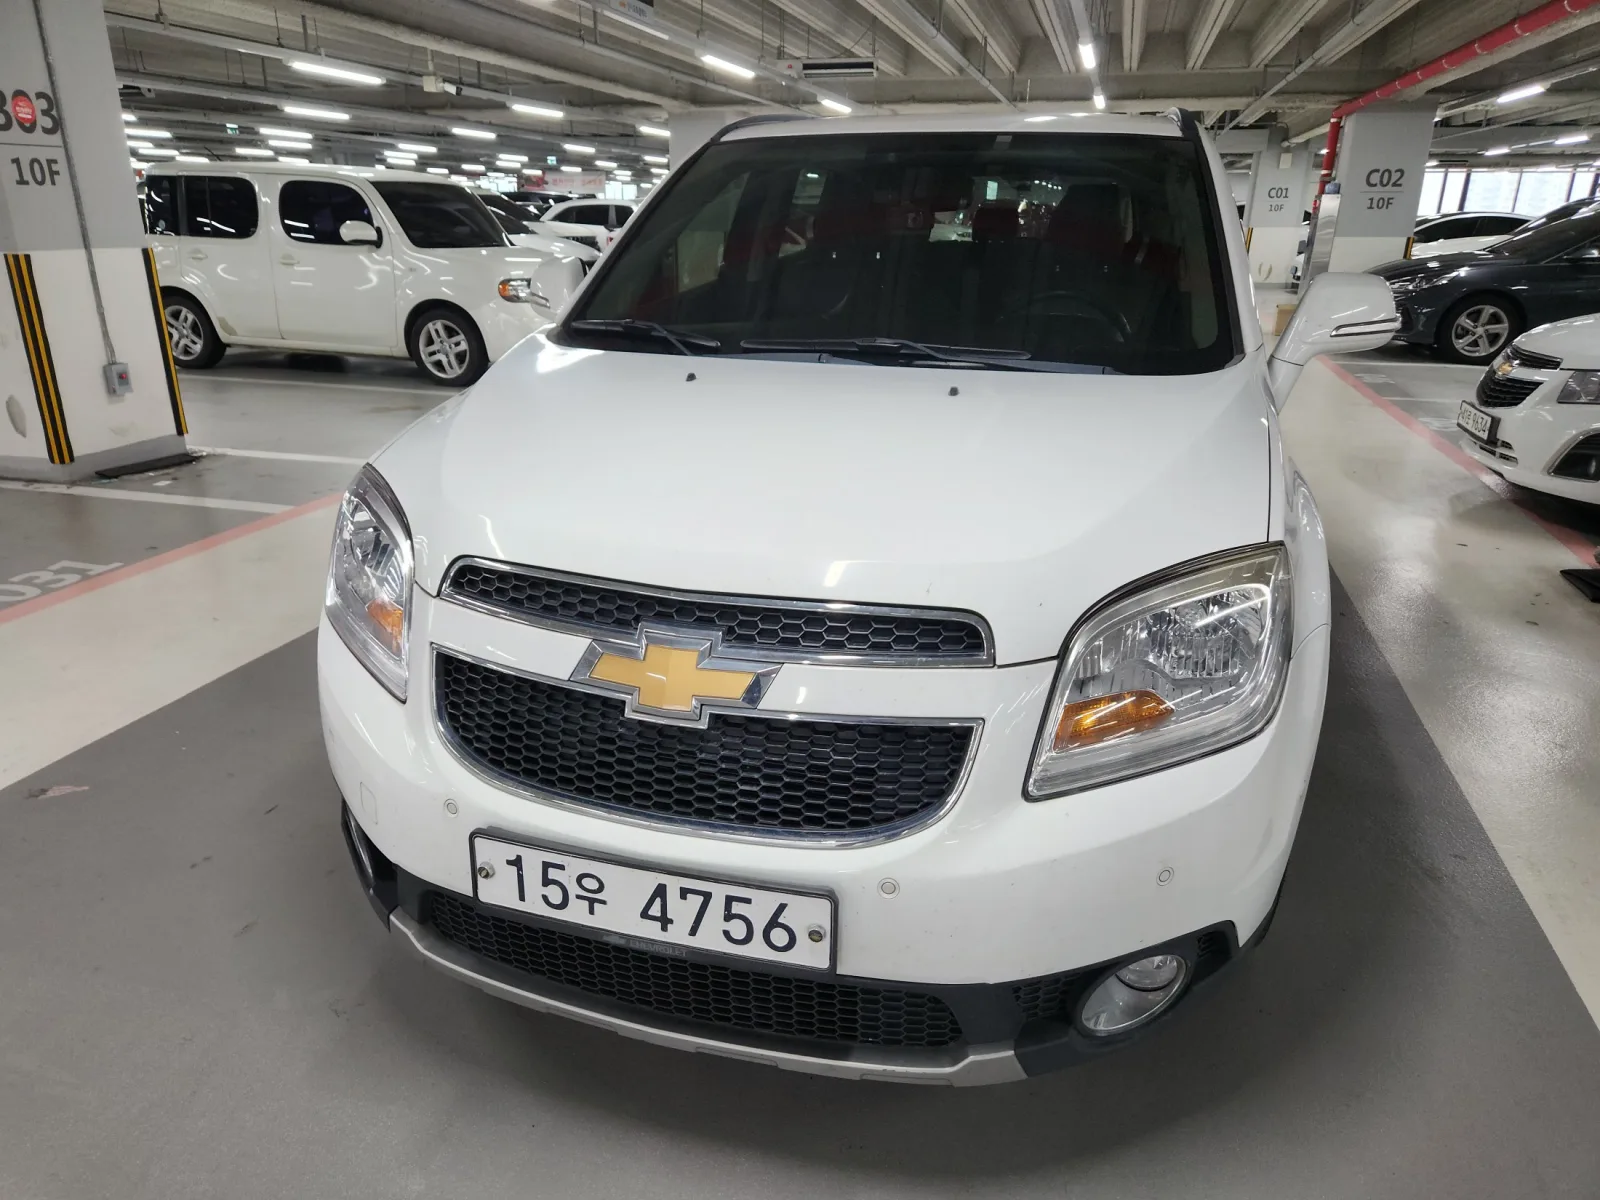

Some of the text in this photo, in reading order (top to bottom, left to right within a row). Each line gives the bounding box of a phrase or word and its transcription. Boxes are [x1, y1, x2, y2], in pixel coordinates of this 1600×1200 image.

[11, 157, 60, 186] 10F
[1365, 168, 1405, 188] C02
[1267, 187, 1290, 199] C01
[1268, 203, 1285, 212] 10F
[1366, 197, 1395, 210] 10F
[506, 854, 797, 953] 15우 4756
